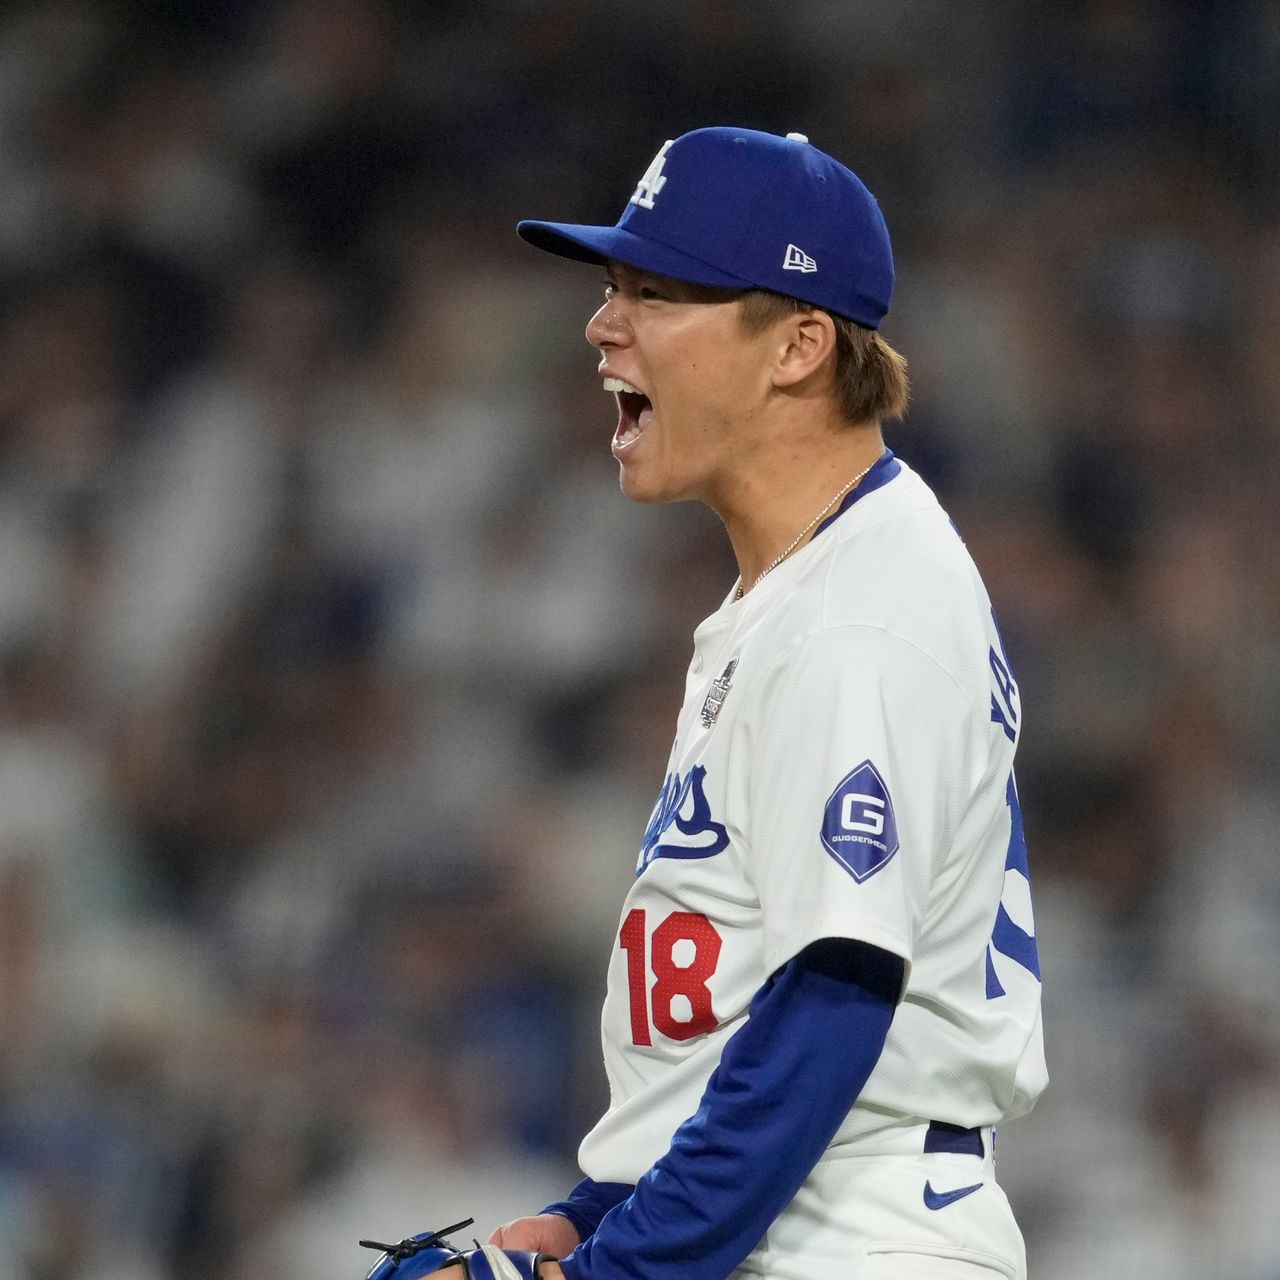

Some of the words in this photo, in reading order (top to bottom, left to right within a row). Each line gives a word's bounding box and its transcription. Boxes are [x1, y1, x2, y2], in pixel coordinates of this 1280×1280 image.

[841, 793, 886, 835] G
[832, 834, 888, 853] GUGGENHEIM
[620, 908, 723, 1047] 18
